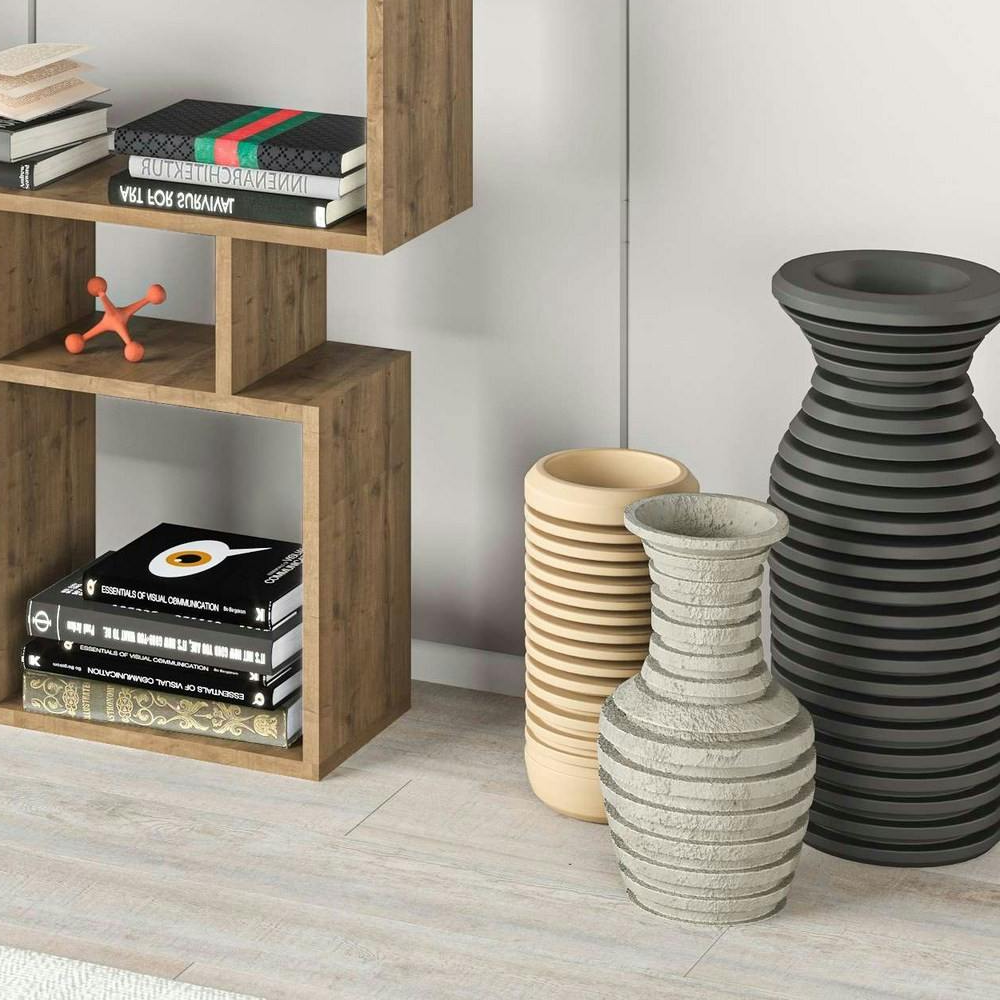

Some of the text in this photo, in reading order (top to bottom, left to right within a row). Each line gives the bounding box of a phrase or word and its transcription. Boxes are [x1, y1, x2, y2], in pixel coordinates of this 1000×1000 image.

[101, 585, 137, 599] ESSENTIALS
[137, 591, 146, 600] OF
[146, 593, 168, 604] VISUAL
[167, 596, 219, 612] COMMUNICATION
[79, 644, 119, 657] ESSENTIALS
[119, 650, 129, 658] OF
[130, 653, 152, 663] VISUAL
[152, 655, 209, 672] COMMUNICATION
[87, 666, 154, 685] COMMUNICATION
[155, 678, 184, 691] VISUAL
[184, 683, 196, 693] OF
[197, 685, 245, 700] ESSENTIALS
